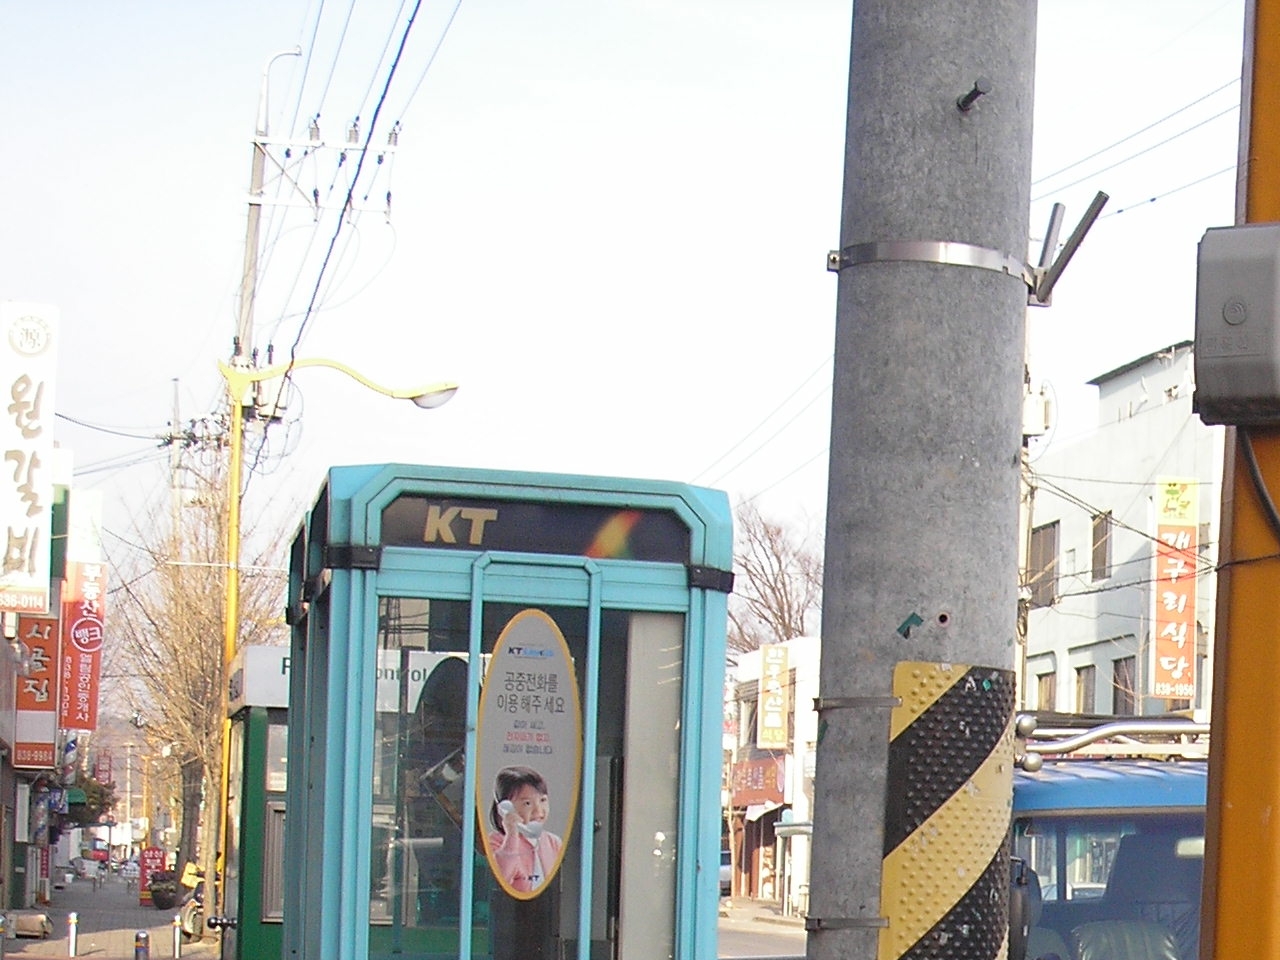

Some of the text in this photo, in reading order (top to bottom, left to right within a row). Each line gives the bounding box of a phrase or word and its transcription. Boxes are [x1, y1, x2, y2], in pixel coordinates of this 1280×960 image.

[4, 373, 44, 577] 원갈비
[424, 505, 497, 545] KT
[80, 563, 102, 617] 부동산
[1161, 530, 1190, 679] 개구리식당
[23, 624, 51, 702] 시골집
[504, 671, 559, 693] 공중전화를
